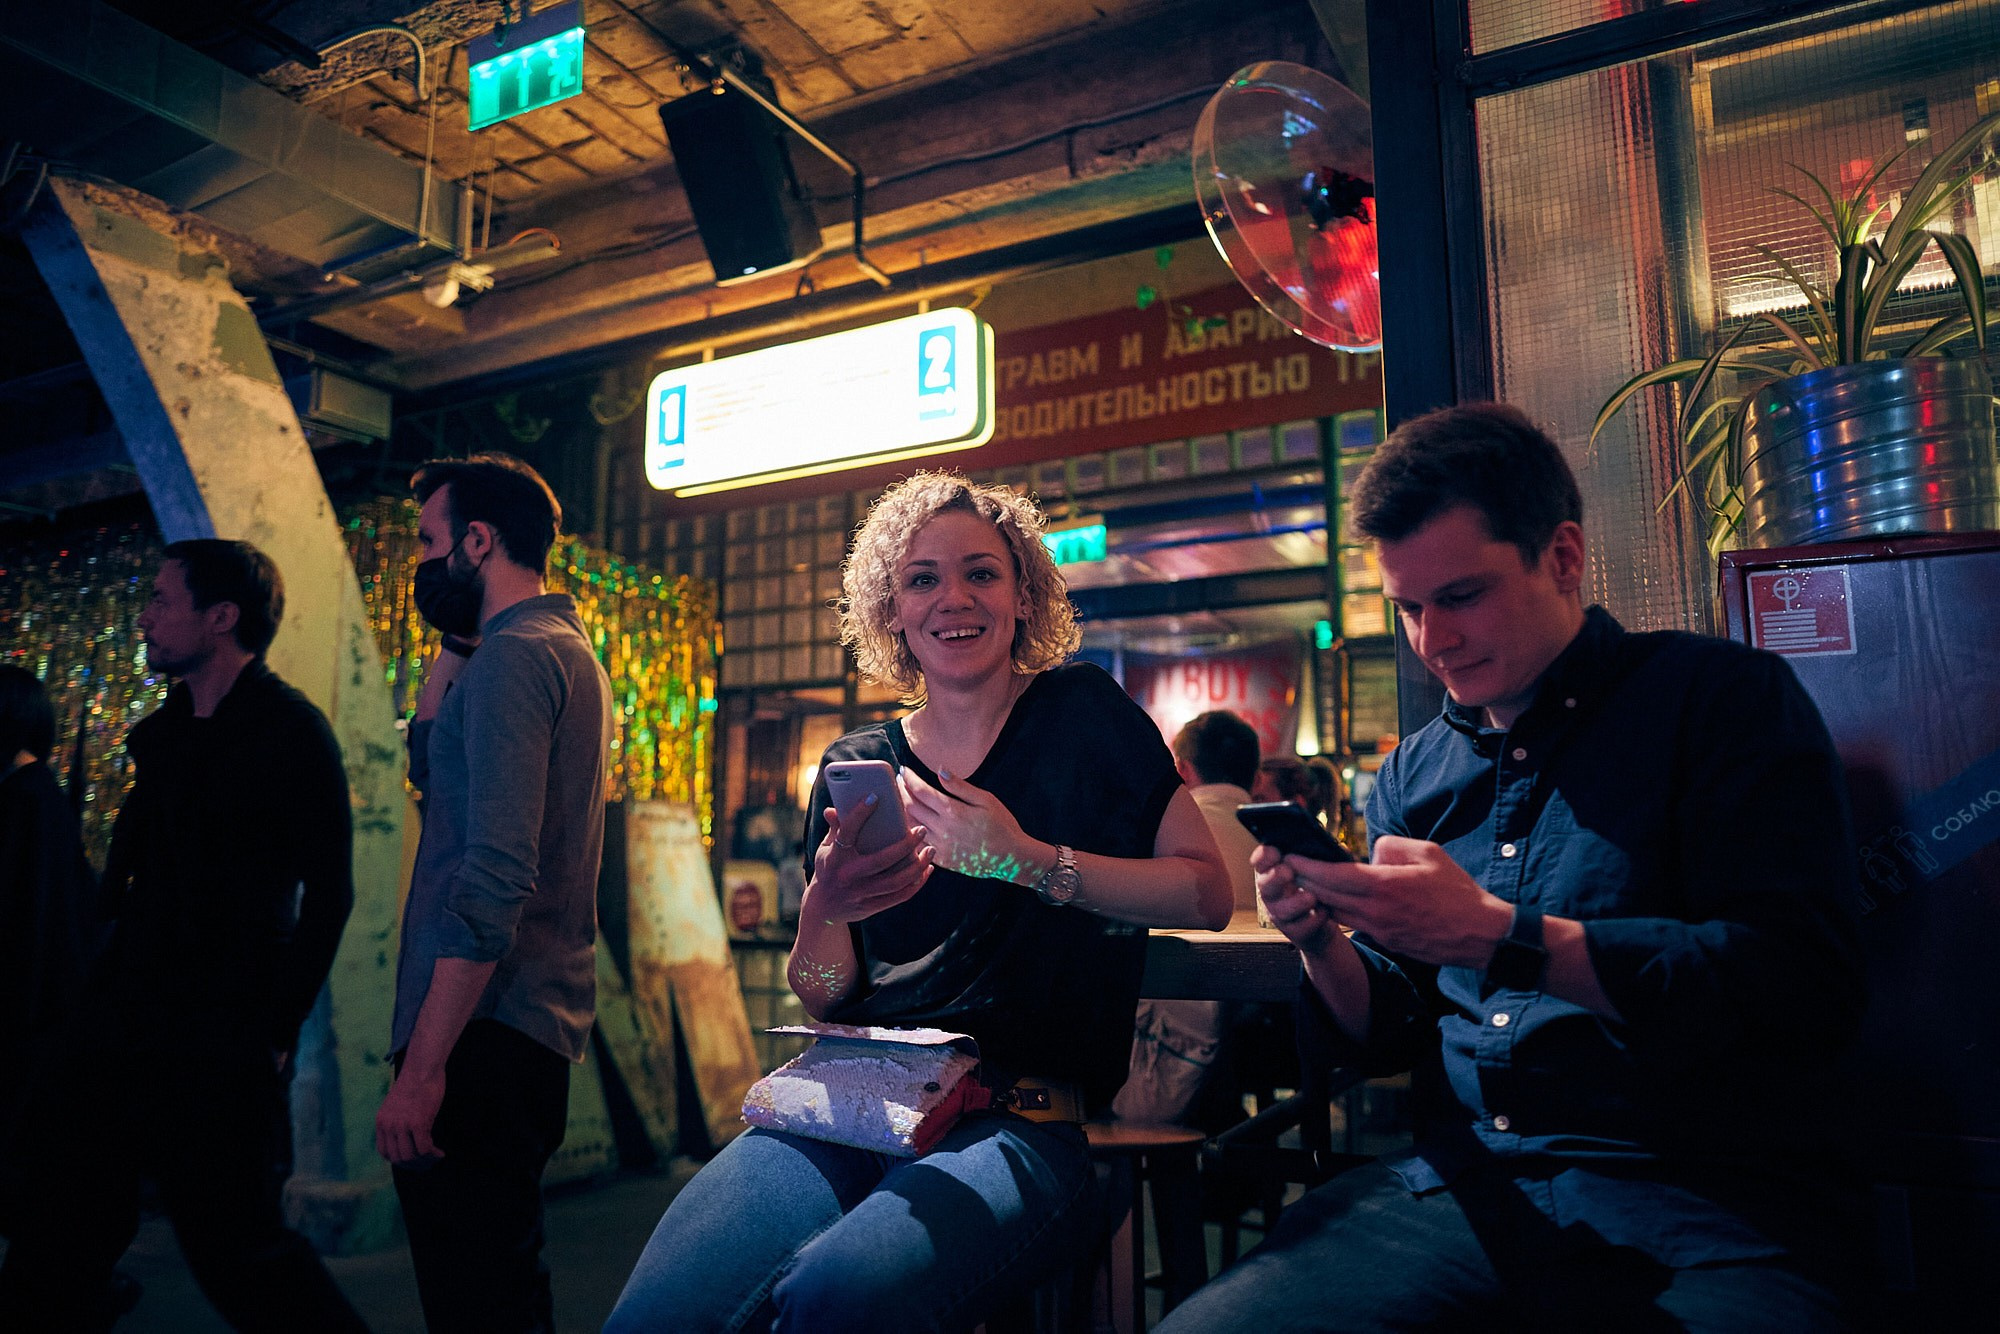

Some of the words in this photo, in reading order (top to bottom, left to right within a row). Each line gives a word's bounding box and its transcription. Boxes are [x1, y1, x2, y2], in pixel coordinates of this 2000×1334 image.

[925, 335, 952, 388] 2
[1120, 331, 1142, 369] И
[661, 393, 681, 441] 1
[1931, 790, 2000, 840] СОБЛЮ
